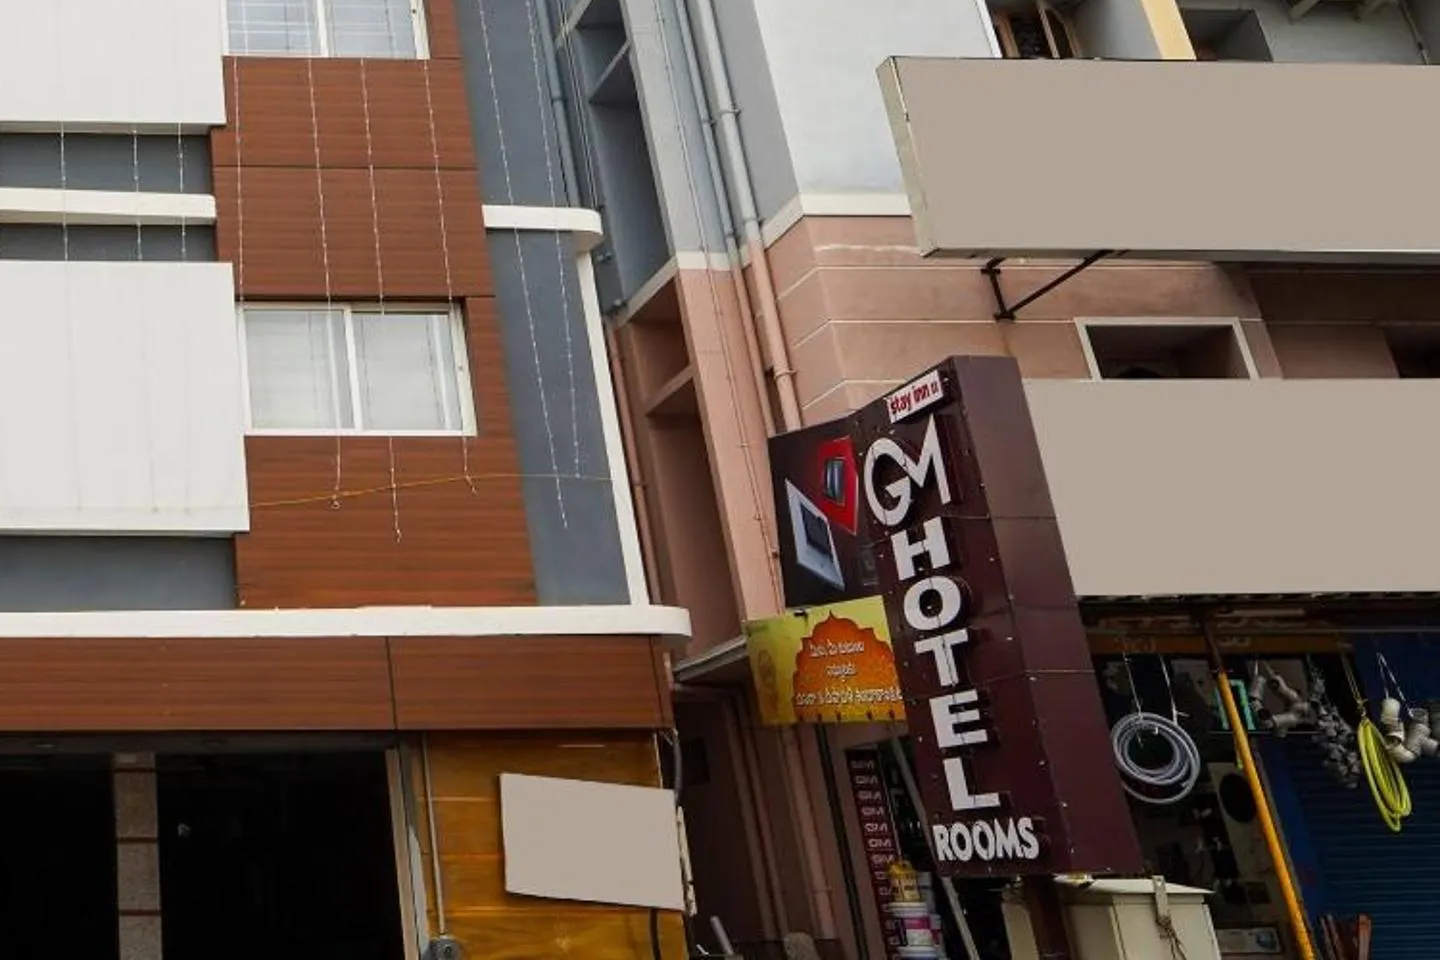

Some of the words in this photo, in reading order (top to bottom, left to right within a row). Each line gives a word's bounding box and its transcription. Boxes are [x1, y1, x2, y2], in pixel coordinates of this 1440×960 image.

[890, 393, 912, 416] stay
[863, 413, 951, 527] GM
[891, 516, 1000, 810] HOTEL
[932, 816, 1041, 862] ROOMS
